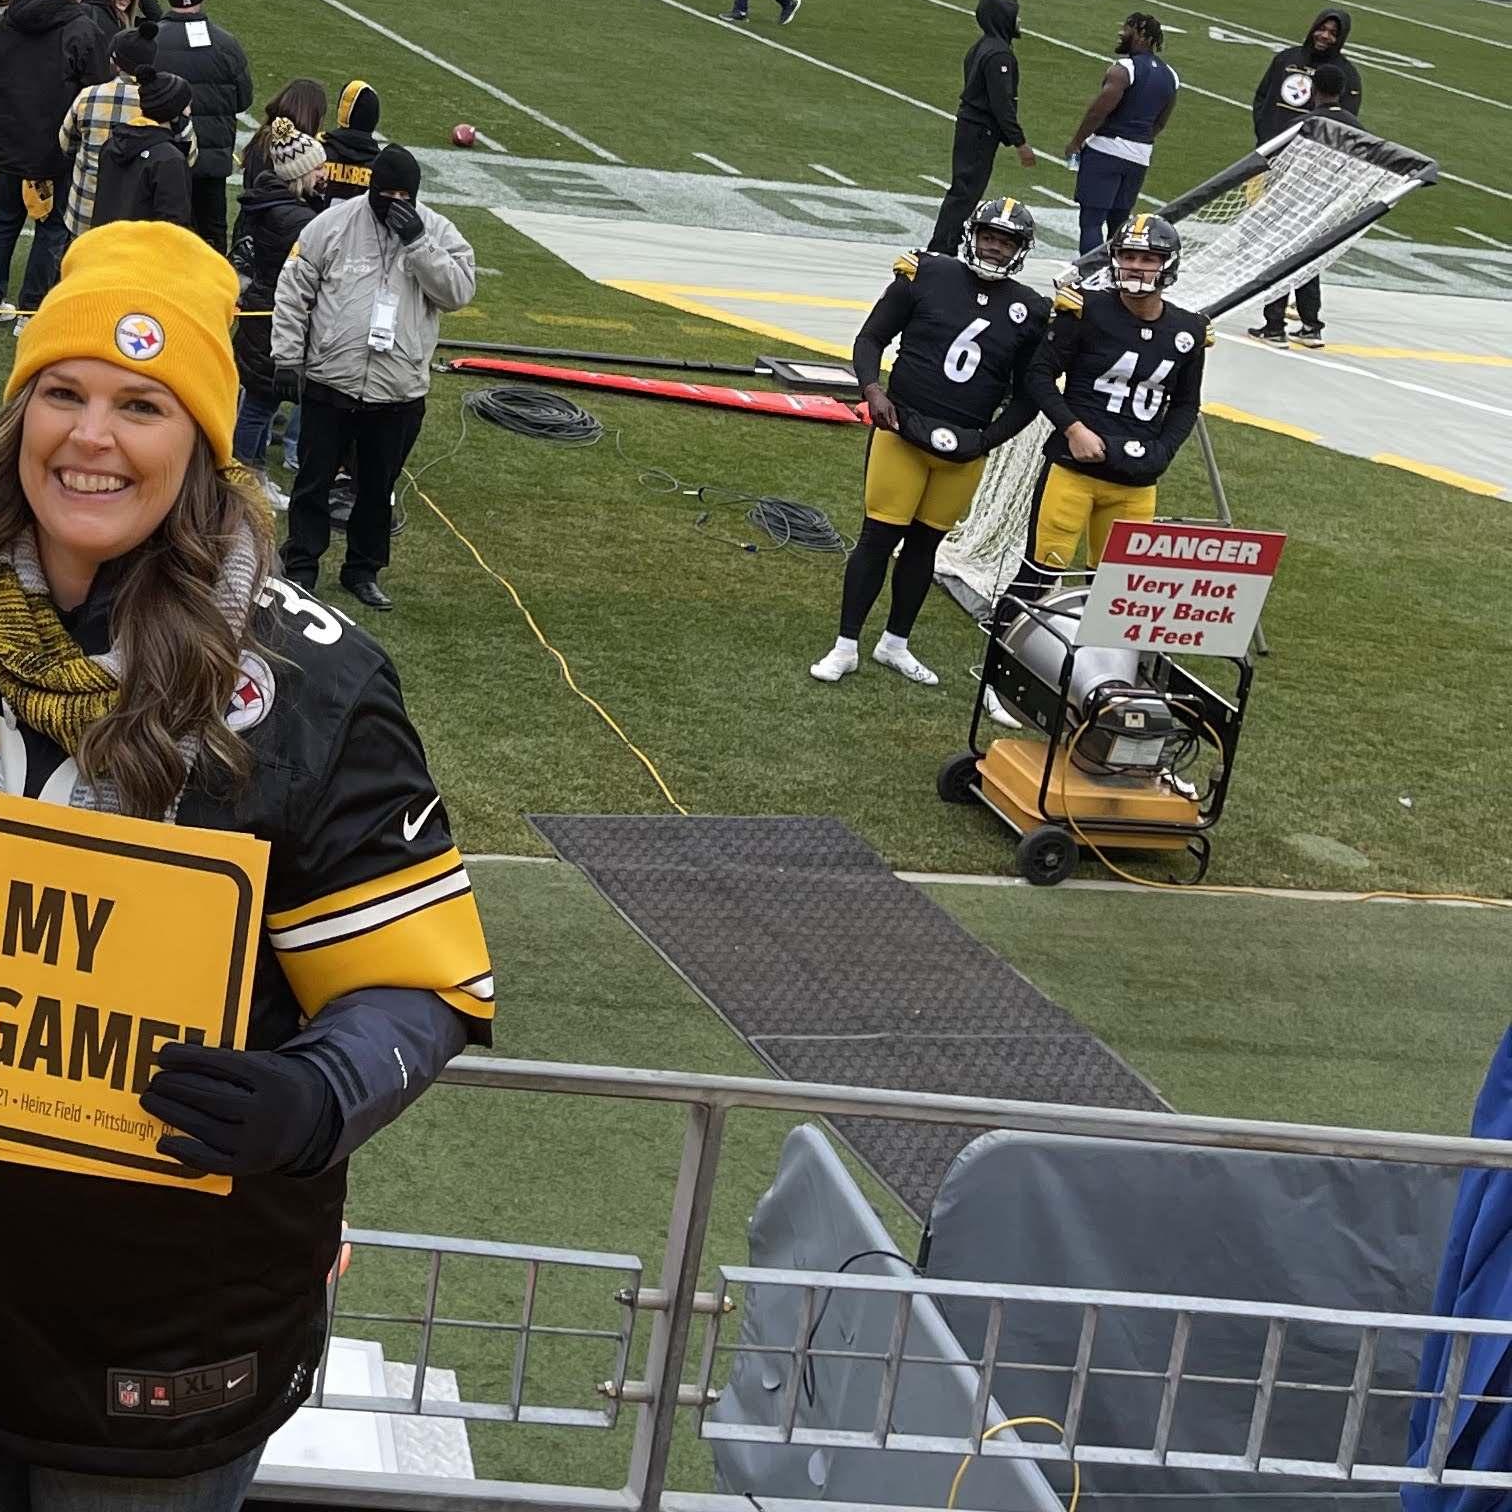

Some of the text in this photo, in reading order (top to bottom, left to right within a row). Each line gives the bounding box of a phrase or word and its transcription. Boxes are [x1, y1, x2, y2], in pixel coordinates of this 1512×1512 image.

[943, 317, 992, 384] 6
[1093, 351, 1176, 422] 46
[1125, 532, 1262, 565] DANGER
[1126, 573, 1237, 599] Very Hot
[1108, 598, 1236, 624] Stay Back
[1124, 624, 1204, 646] 4 Feet
[1, 879, 116, 974] MY
[20, 1093, 52, 1117] Heinz
[54, 1099, 81, 1123] Field
[94, 1109, 157, 1142] Pittsburgh,
